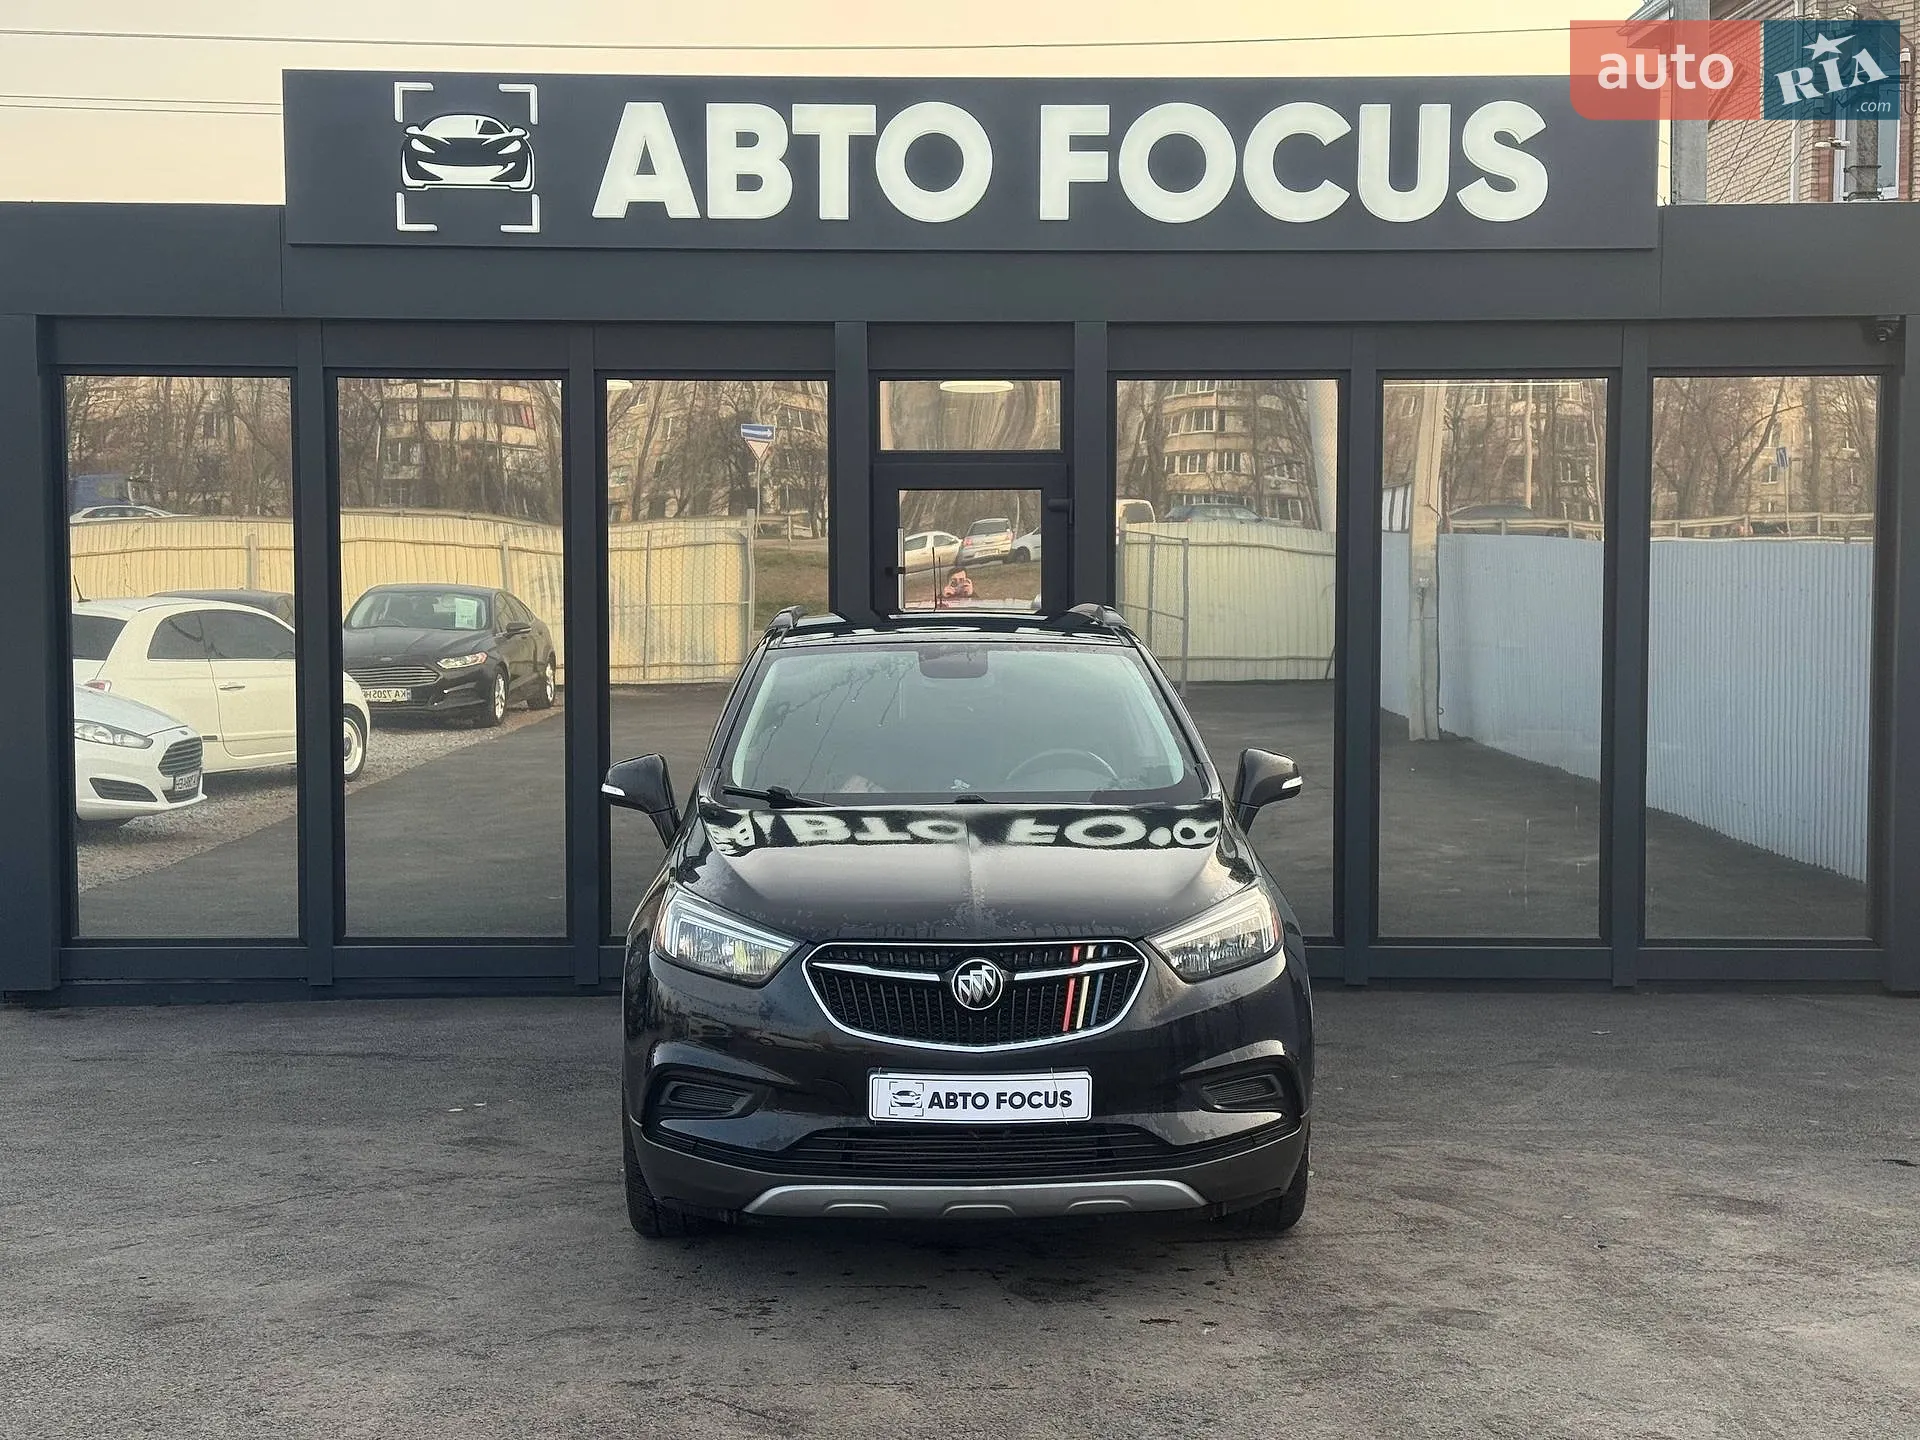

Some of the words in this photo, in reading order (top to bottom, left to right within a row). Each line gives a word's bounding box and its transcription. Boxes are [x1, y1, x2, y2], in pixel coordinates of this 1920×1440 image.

[592, 101, 993, 223] АВТО
[1040, 101, 1549, 223] FOCUS
[928, 1091, 990, 1110] АВТО
[996, 1090, 1073, 1109] FOCUS
